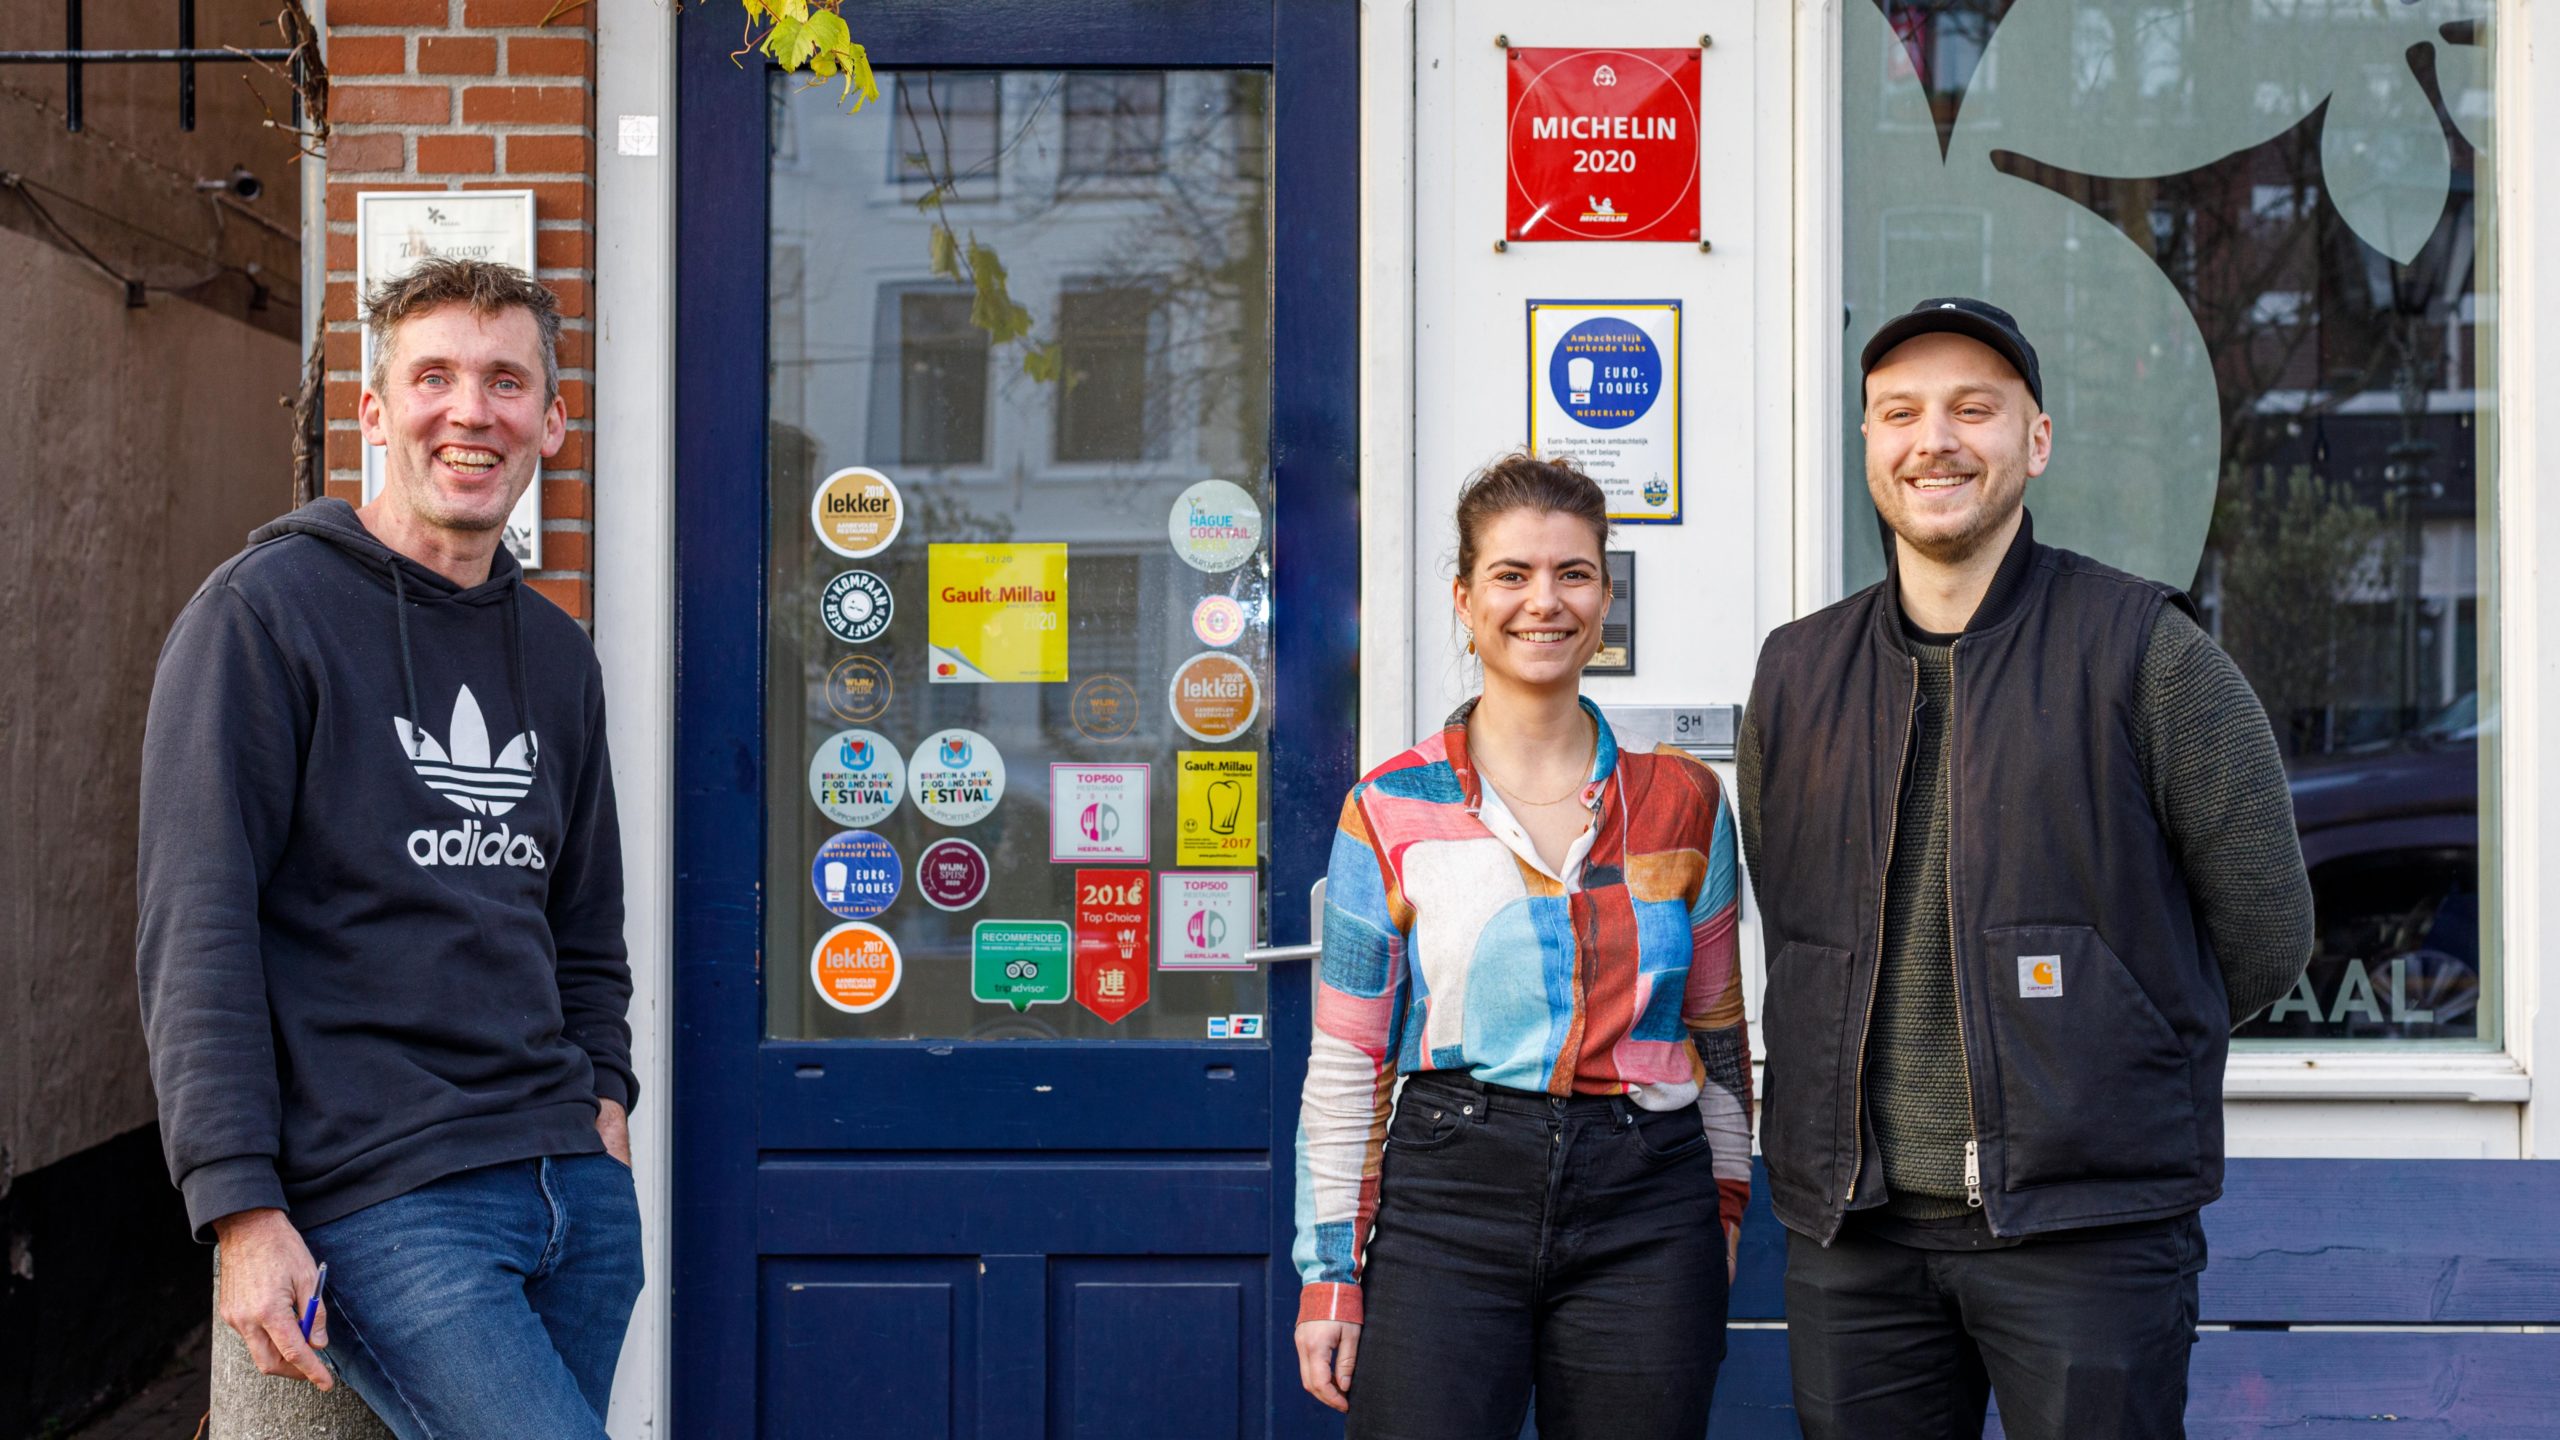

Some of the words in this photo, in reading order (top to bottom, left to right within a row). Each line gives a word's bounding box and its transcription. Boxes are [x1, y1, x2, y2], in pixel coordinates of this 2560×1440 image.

[1532, 116, 1676, 140] MICHELIN
[1573, 150, 1636, 173] 2020
[1571, 334, 1641, 344] Ambachtelijk
[1566, 344, 1617, 352] werkende
[1622, 344, 1646, 352] koks
[1604, 366, 1645, 379] EURO-
[1598, 382, 1648, 395] TOQUES
[1577, 409, 1635, 417] NEDERLAND
[1590, 437, 1606, 445] koks
[1608, 437, 1648, 446] ambachtelijk
[1599, 449, 1621, 457] belang
[828, 493, 890, 513] lekker
[1189, 515, 1233, 527] HAGUE
[1190, 527, 1251, 539] COCKTAIL
[832, 574, 888, 606] KOMPAAN
[826, 604, 848, 633] BEER
[1024, 611, 1057, 631] 2020
[848, 615, 883, 637] CRAFT
[1183, 678, 1247, 697] lekker
[921, 780, 944, 788] FOOD
[968, 779, 992, 787] DRINK
[1077, 774, 1124, 783] TOP500
[822, 789, 894, 805] FESTIVAL
[921, 788, 993, 804] FESTIVAL
[407, 819, 546, 870] adidas
[827, 842, 887, 850] Ambachtelijk
[1221, 837, 1252, 849] 2017
[823, 850, 867, 858] werkende
[870, 850, 892, 858] koks
[856, 869, 891, 880] EURO-
[851, 883, 894, 894] TOQUES
[1184, 881, 1229, 890] TOP500
[1082, 883, 1143, 906] 2016
[1082, 912, 1103, 924] Top
[1105, 912, 1142, 923] Choice
[982, 933, 1062, 943] RECOMMENDED
[863, 940, 884, 953] 2017
[825, 947, 889, 968] lekker
[1098, 968, 1126, 996] 連
[994, 984, 1046, 993] tripadvisor
[2258, 959, 2434, 1022] AAL
